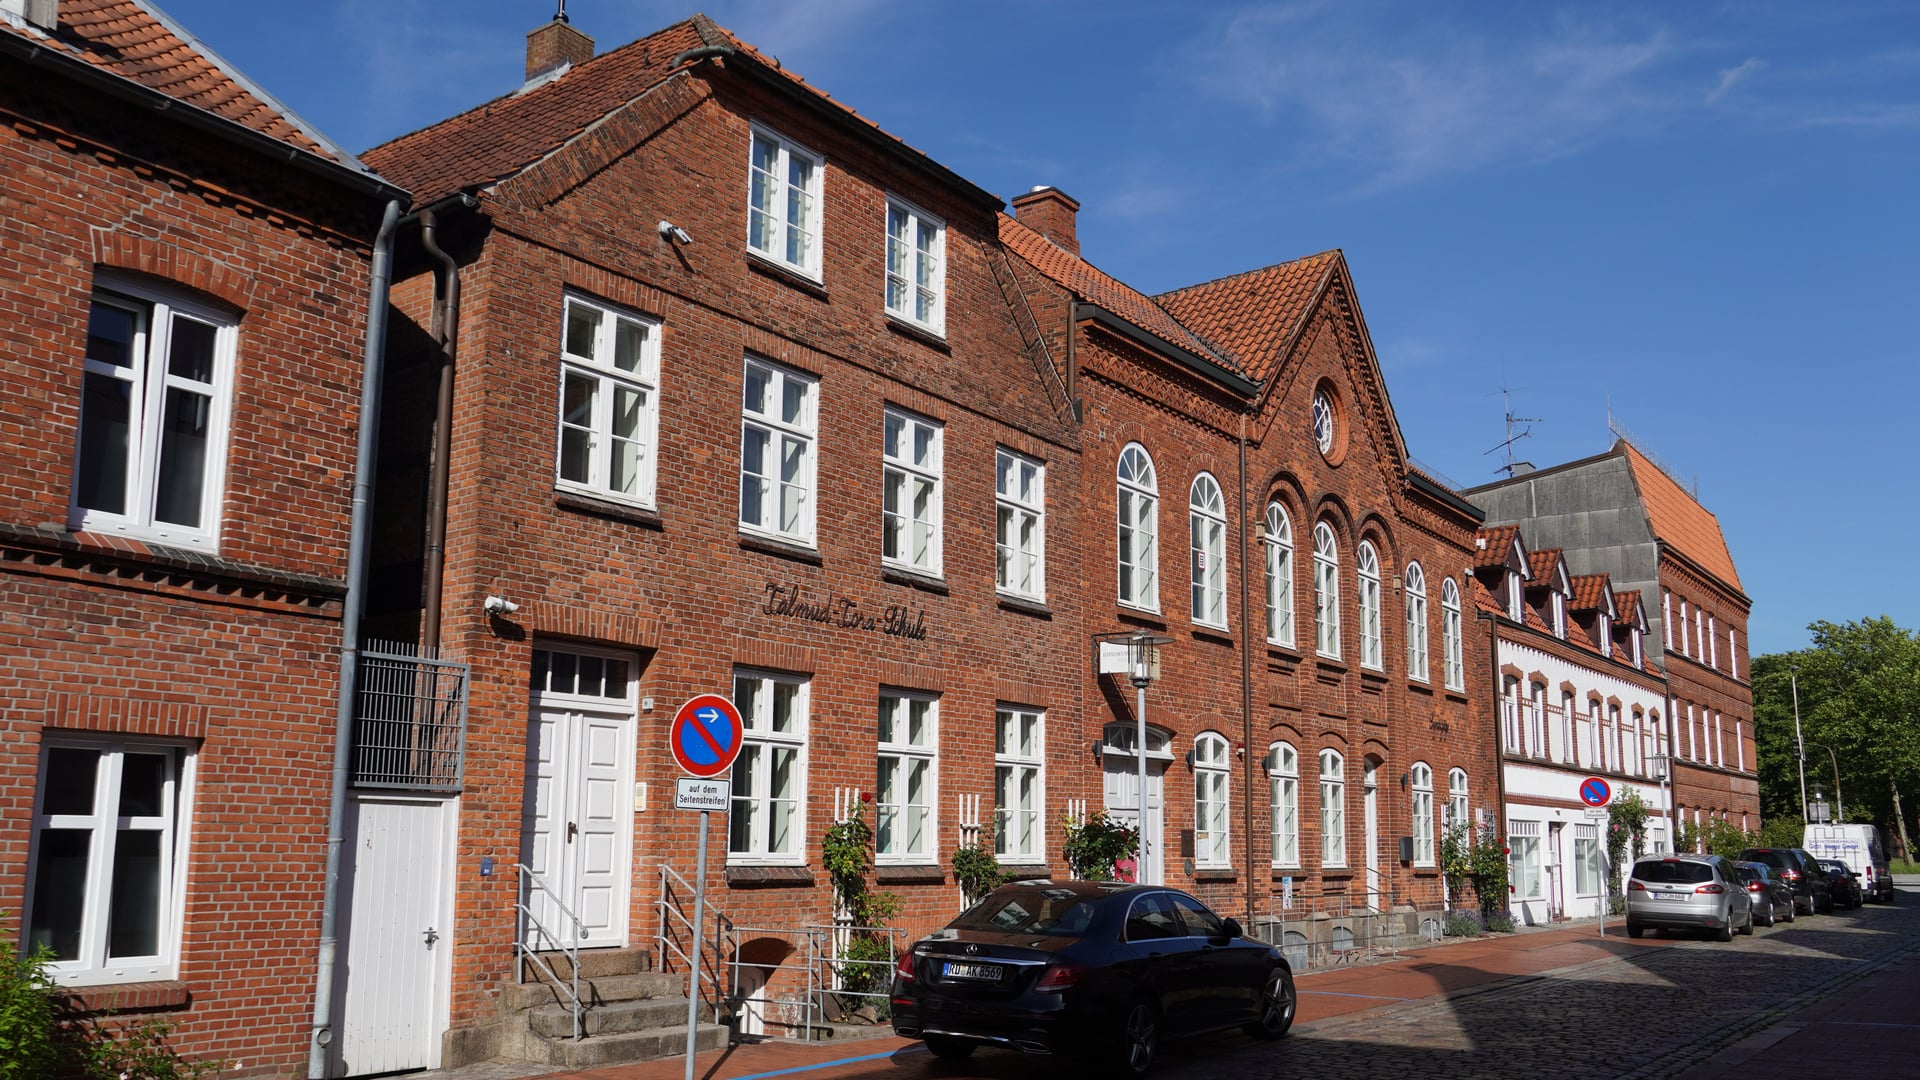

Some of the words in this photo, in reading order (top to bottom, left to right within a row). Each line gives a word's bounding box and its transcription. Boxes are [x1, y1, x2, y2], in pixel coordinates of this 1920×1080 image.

[689, 784, 700, 793] auf
[703, 784, 717, 794] dem
[679, 794, 726, 805] Seitenstreifen
[949, 963, 960, 975] RD
[966, 965, 977, 976] AK
[979, 966, 1002, 978] 8569
